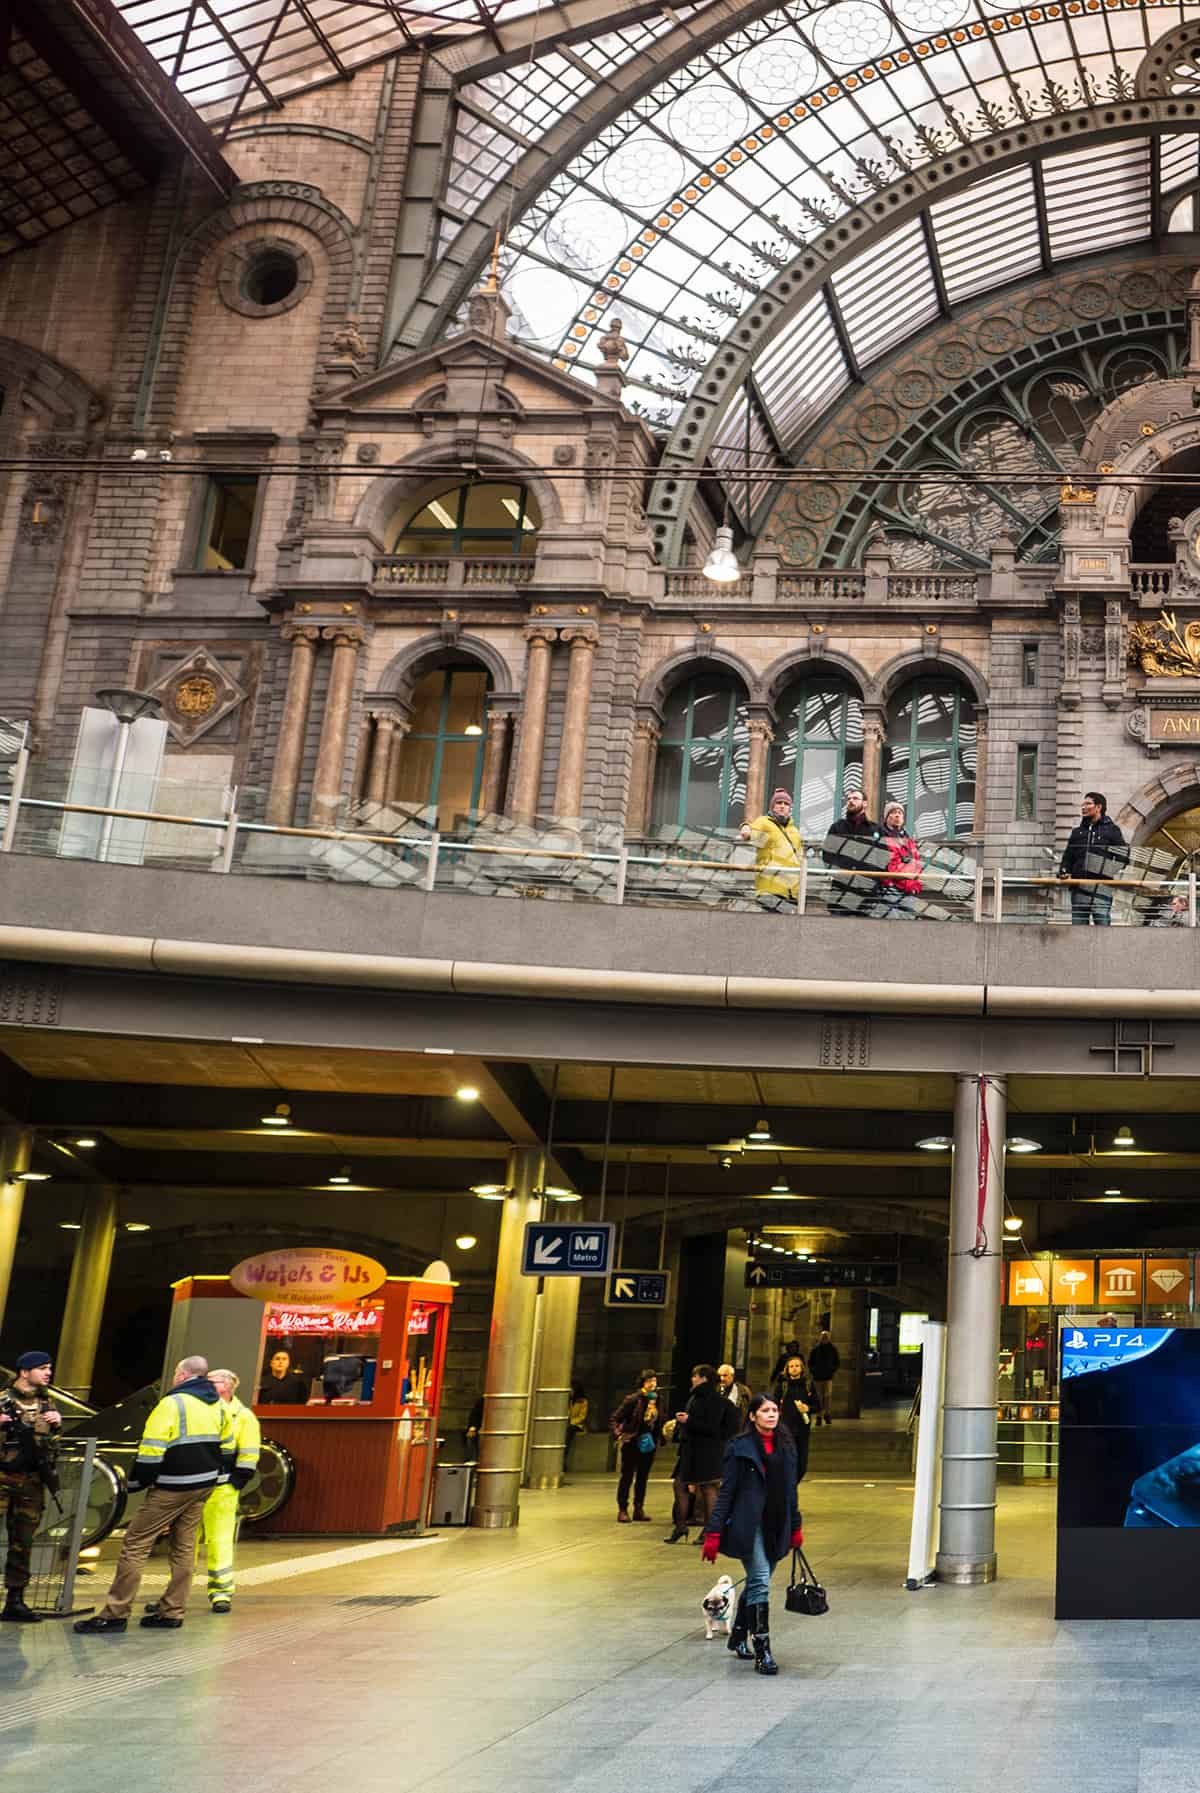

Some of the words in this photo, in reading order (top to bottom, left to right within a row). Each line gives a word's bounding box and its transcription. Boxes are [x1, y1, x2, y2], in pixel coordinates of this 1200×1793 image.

[573, 1253, 598, 1263] Metro
[246, 1263, 314, 1287] Wafels
[319, 1264, 337, 1283] &
[343, 1264, 370, 1284] IJs
[1093, 1334, 1145, 1347] PS4
